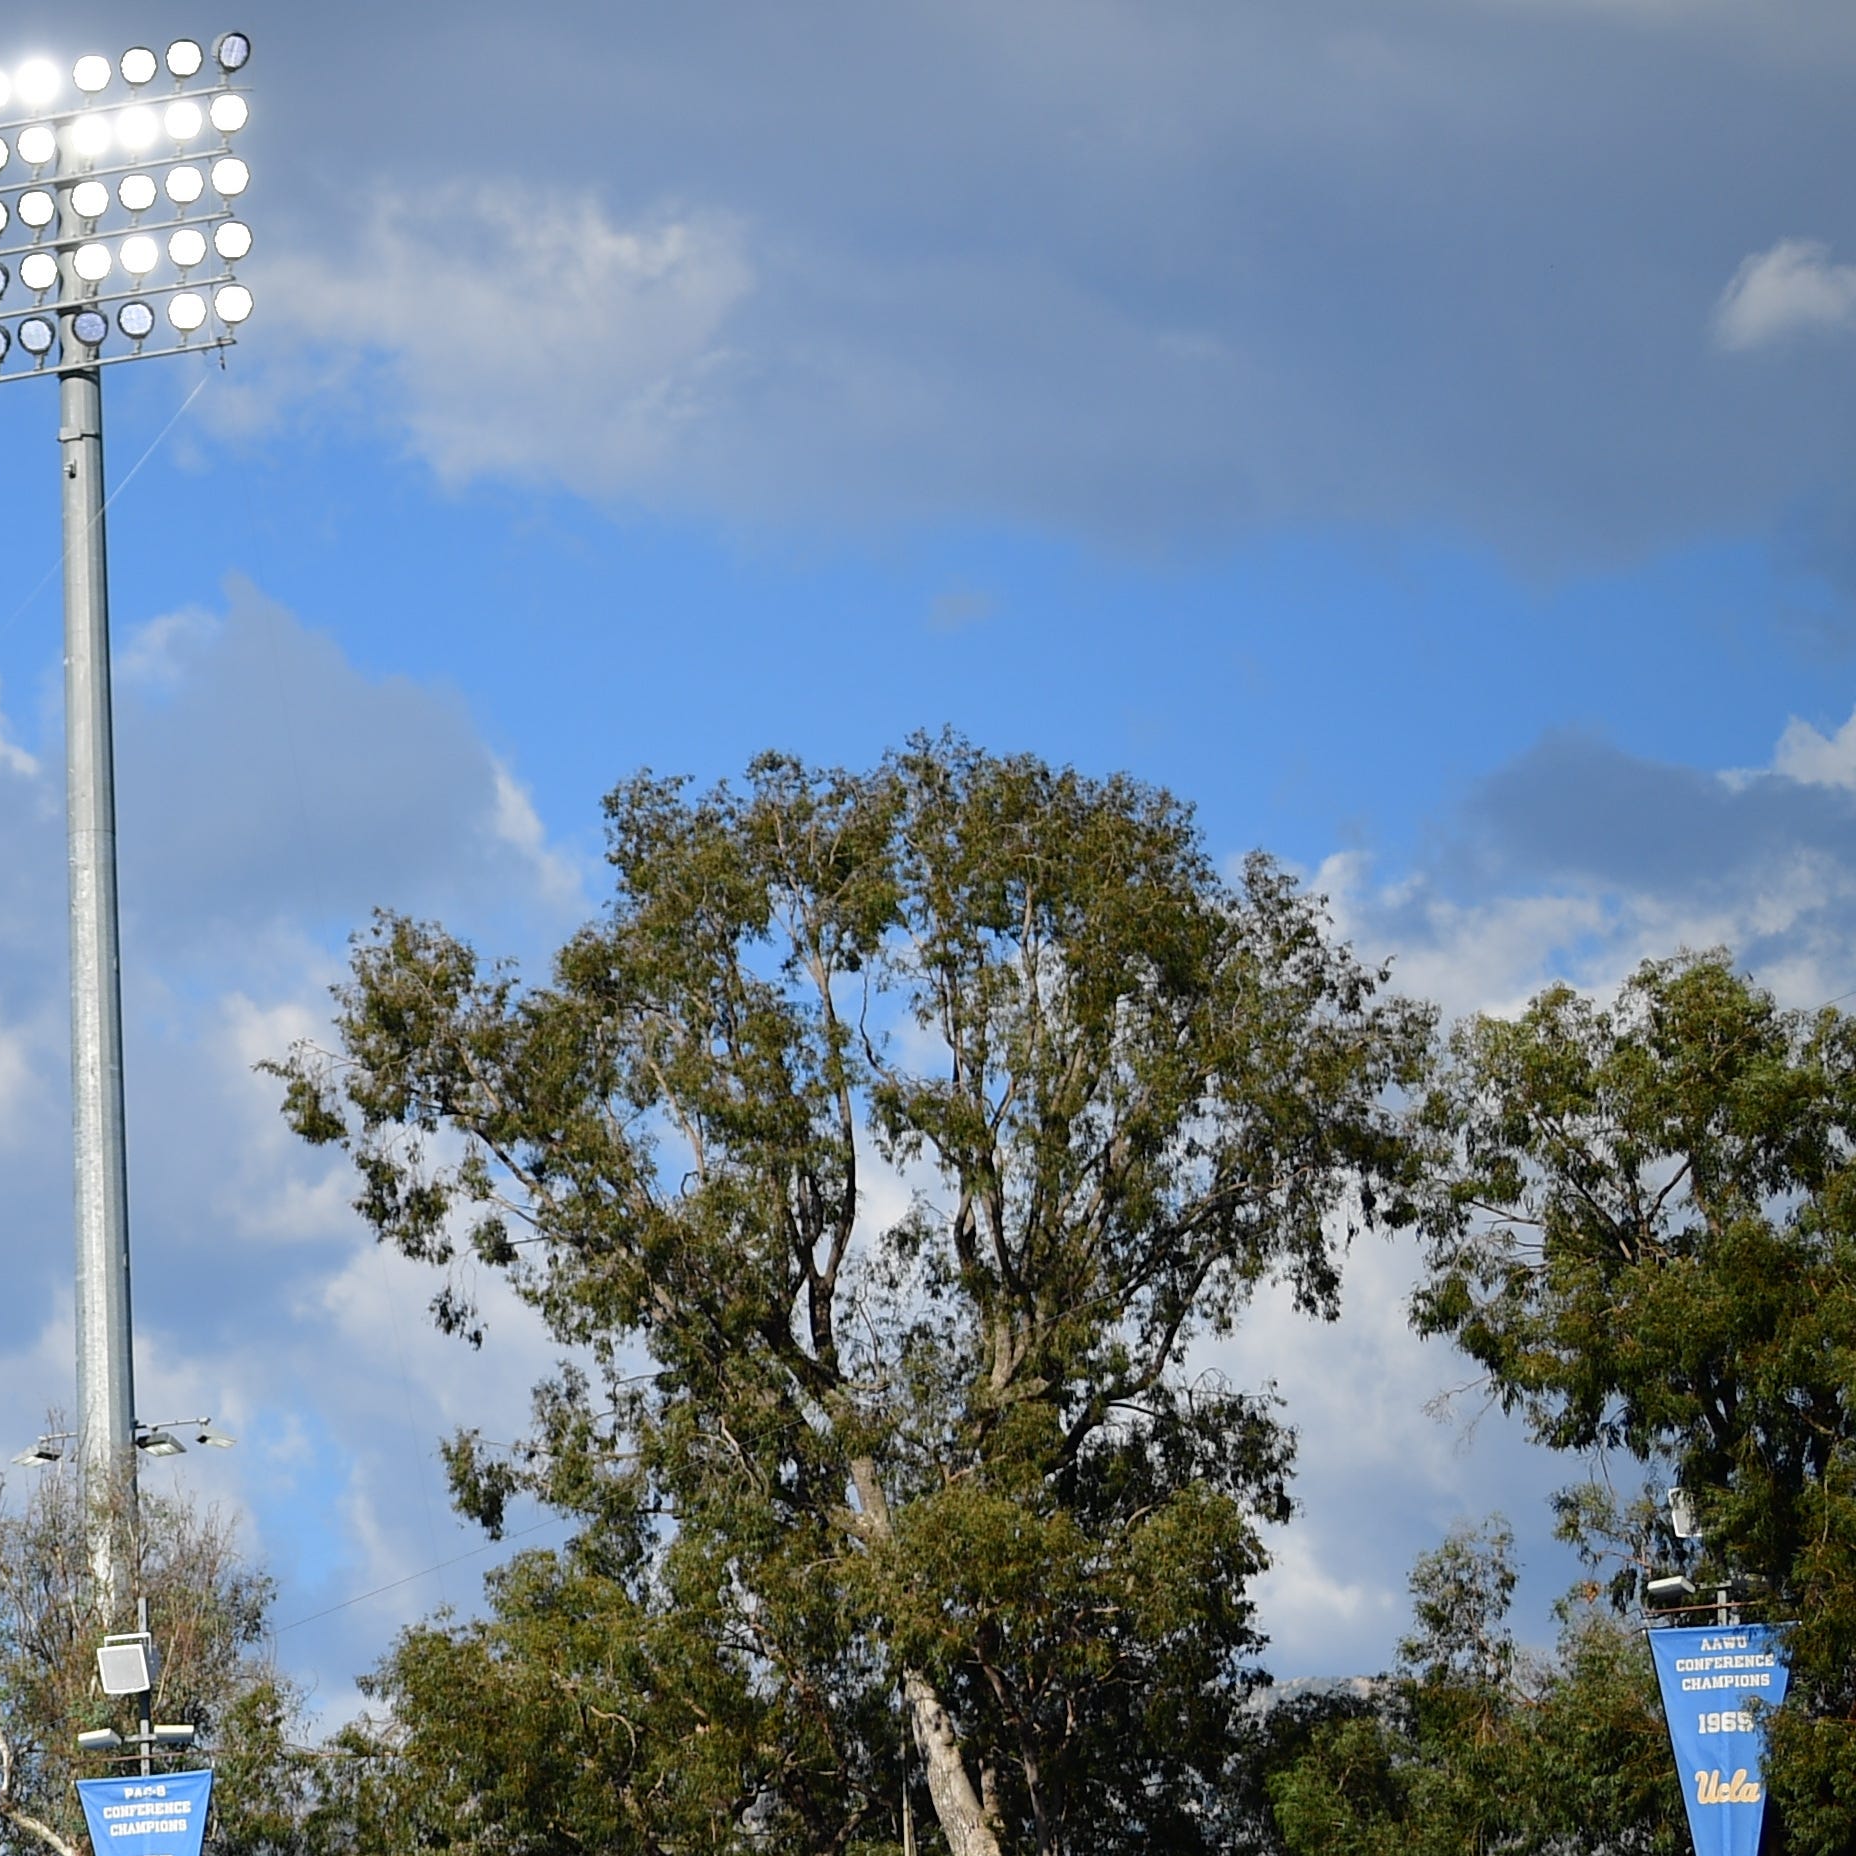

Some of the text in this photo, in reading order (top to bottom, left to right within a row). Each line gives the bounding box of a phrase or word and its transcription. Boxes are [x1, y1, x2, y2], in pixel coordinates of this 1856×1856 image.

[1701, 1637, 1747, 1651] AAWU
[1676, 1654, 1775, 1672] CONFERENCE
[1682, 1673, 1771, 1691] CHAMPIONS
[1695, 1769, 1761, 1805] Ucla
[103, 1801, 192, 1820] CONFERENCE
[110, 1819, 187, 1837] CHAMPIONS
